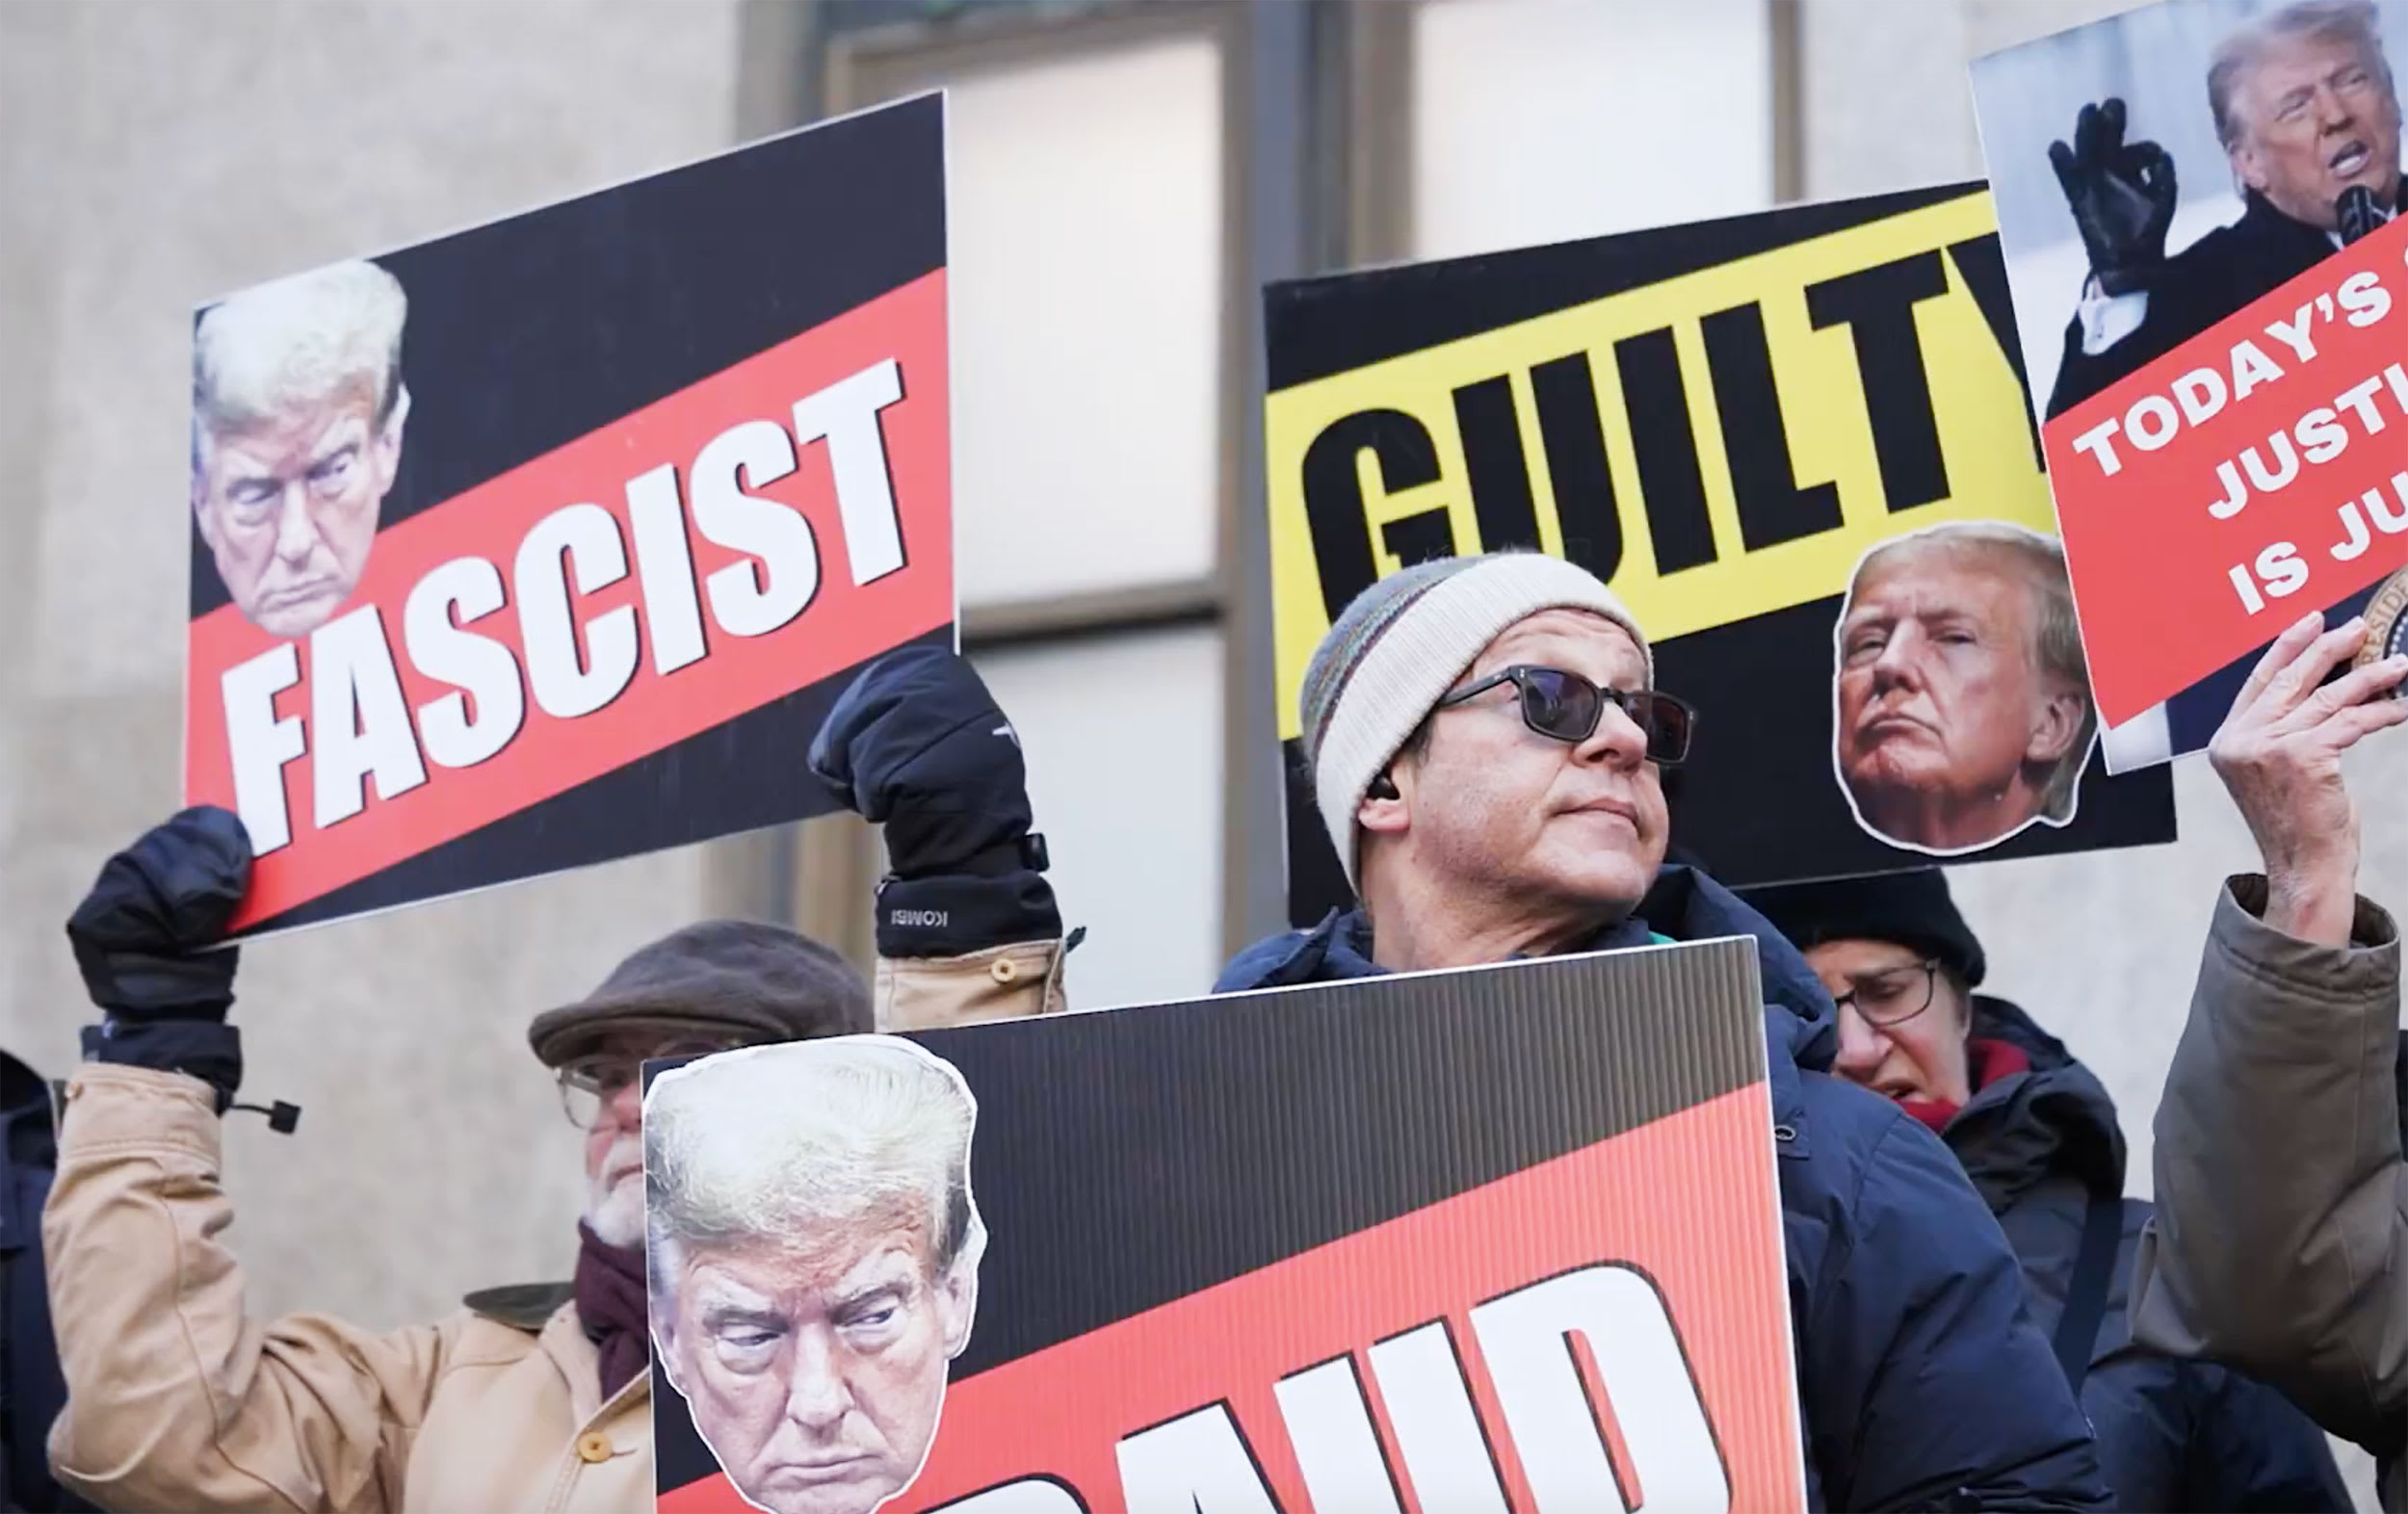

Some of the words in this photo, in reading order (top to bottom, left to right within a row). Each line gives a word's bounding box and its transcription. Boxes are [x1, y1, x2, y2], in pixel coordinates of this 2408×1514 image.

[2073, 272, 2393, 477] TODAY'S
[221, 357, 908, 858] FASCIST
[2228, 541, 2310, 615] IS
[2330, 471, 2408, 561] JU
